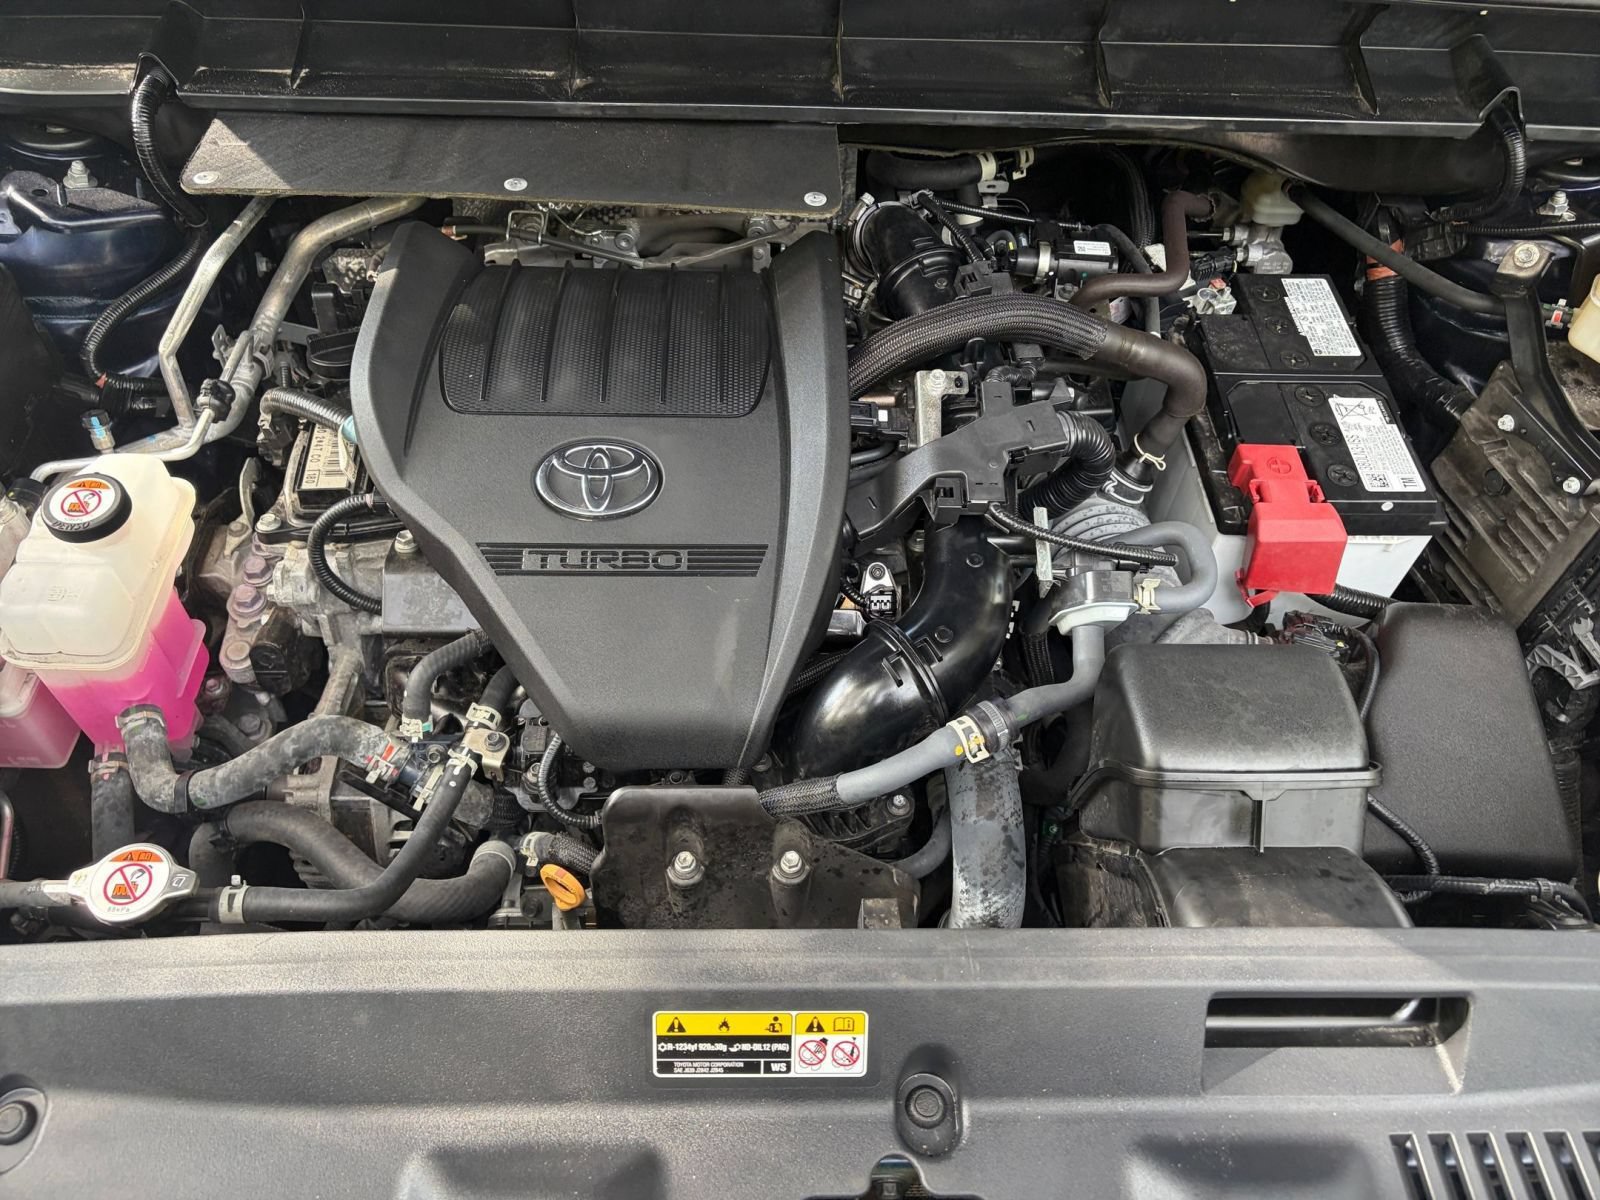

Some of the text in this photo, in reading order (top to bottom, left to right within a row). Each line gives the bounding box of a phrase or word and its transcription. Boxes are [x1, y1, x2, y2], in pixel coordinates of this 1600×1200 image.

[1400, 477, 1418, 488] TM
[52, 521, 92, 531] DENSO
[521, 549, 687, 570] TURBO
[771, 1043, 789, 1052] (PAG)
[770, 1062, 787, 1072] WS
